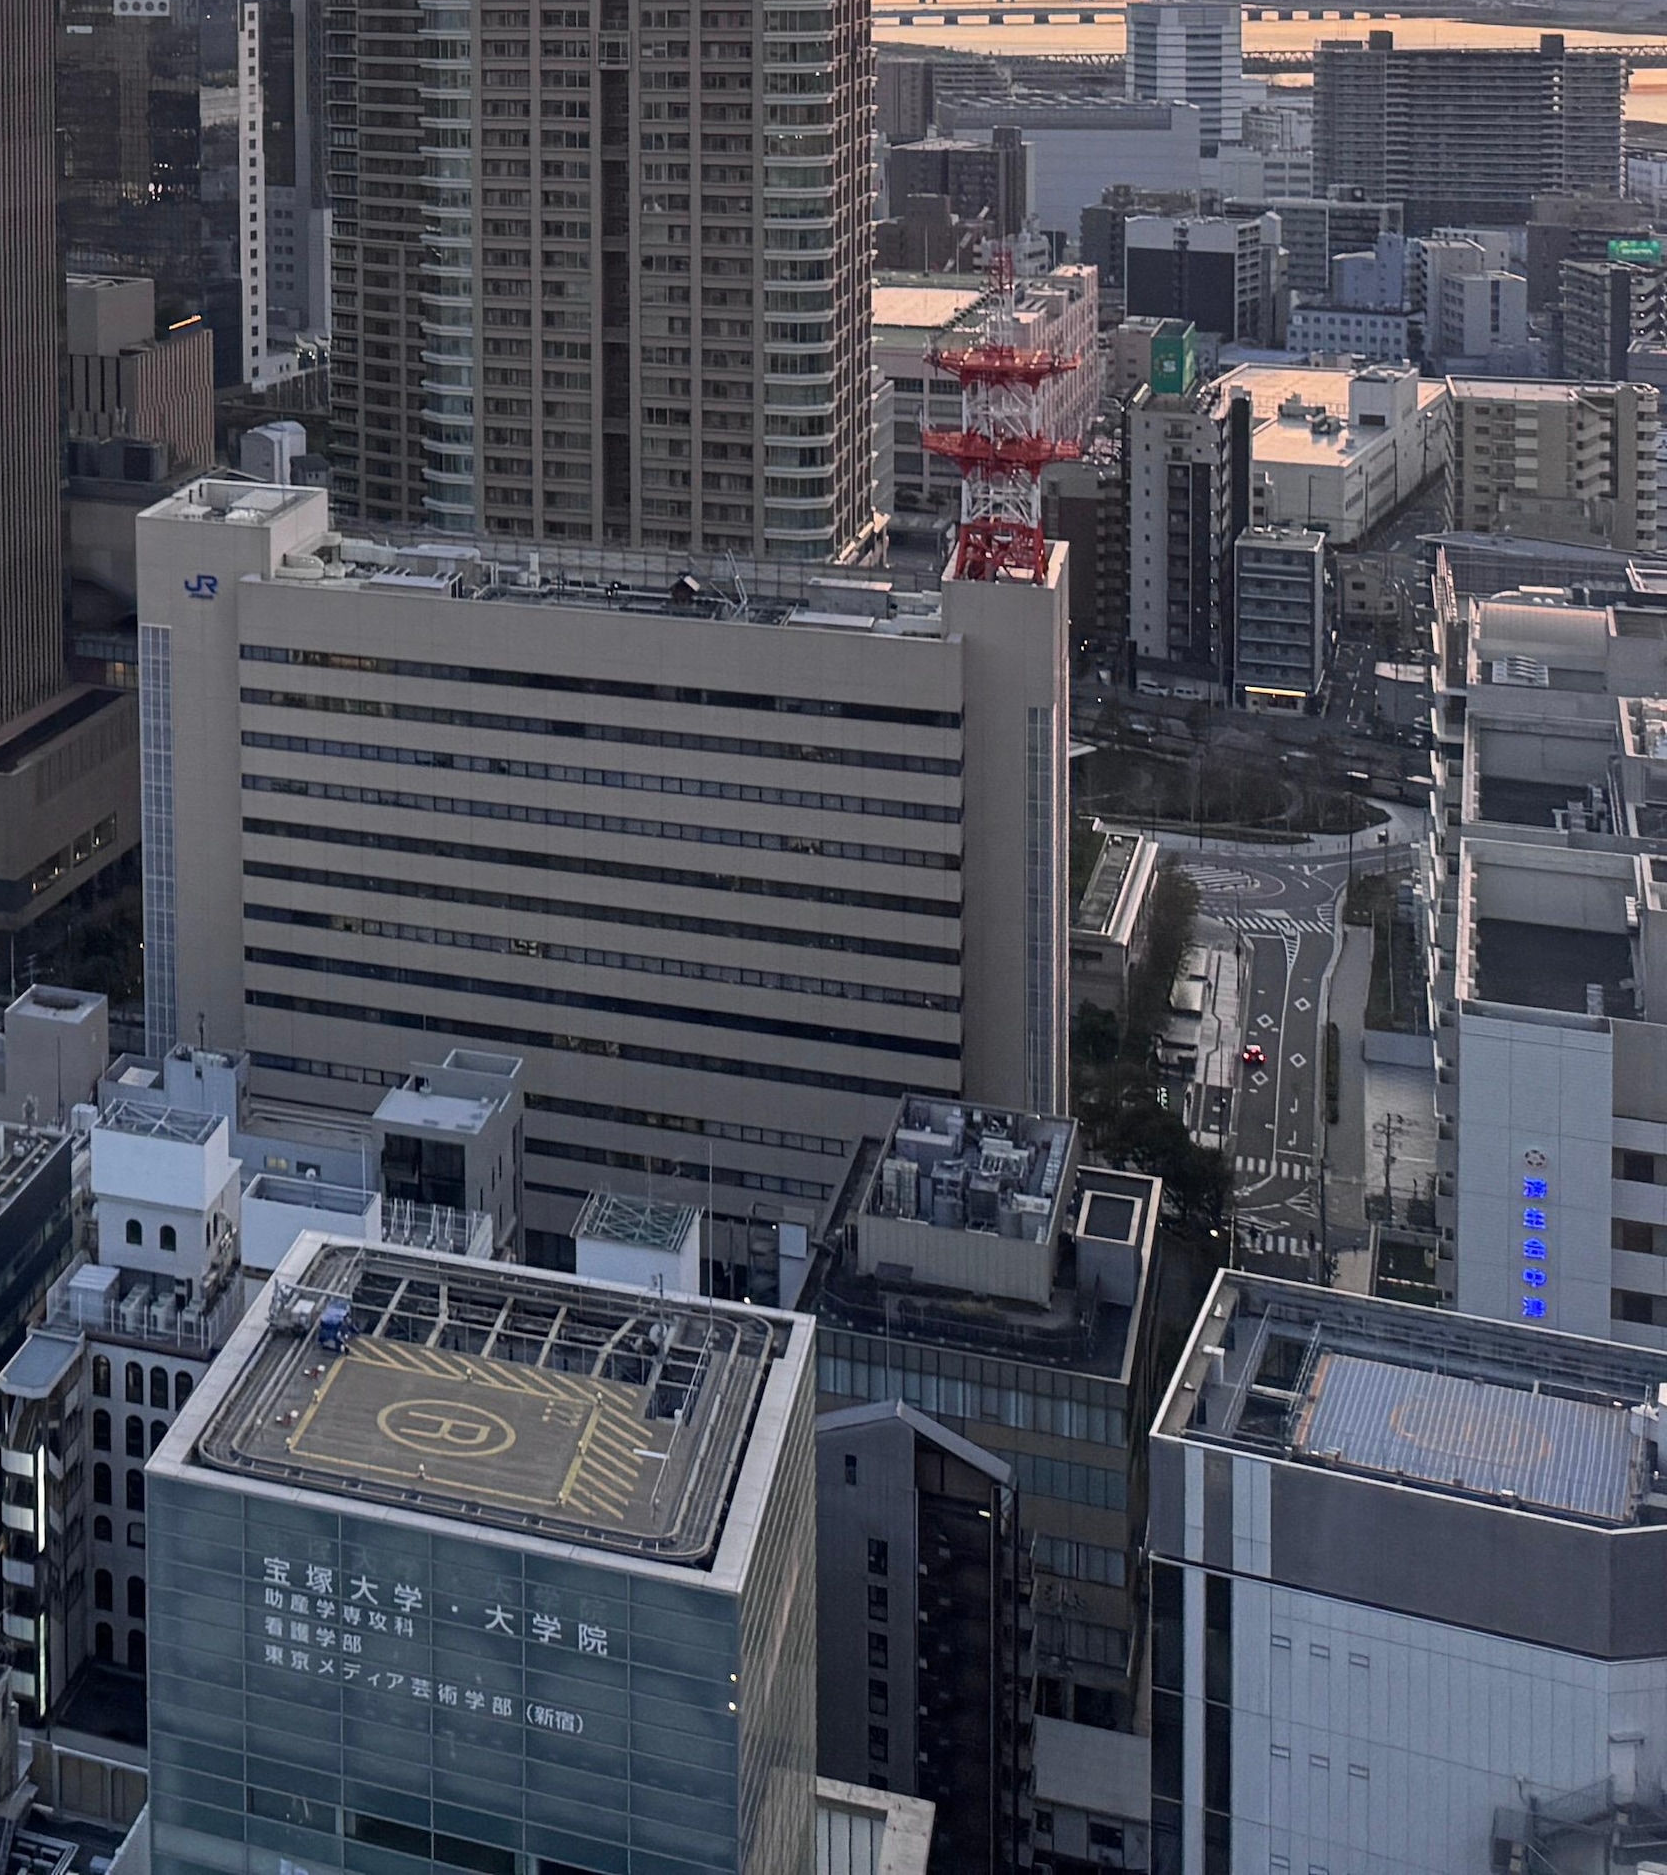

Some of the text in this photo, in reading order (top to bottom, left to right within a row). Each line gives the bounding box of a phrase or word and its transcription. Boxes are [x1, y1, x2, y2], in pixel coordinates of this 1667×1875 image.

[184, 574, 218, 594] JR
[1522, 1176, 1548, 1318] 済生会中津
[263, 1556, 609, 1656] 宝塚大学・大学院
[264, 1587, 415, 1638] 助産学専攻科
[264, 1615, 363, 1655] 看護学部
